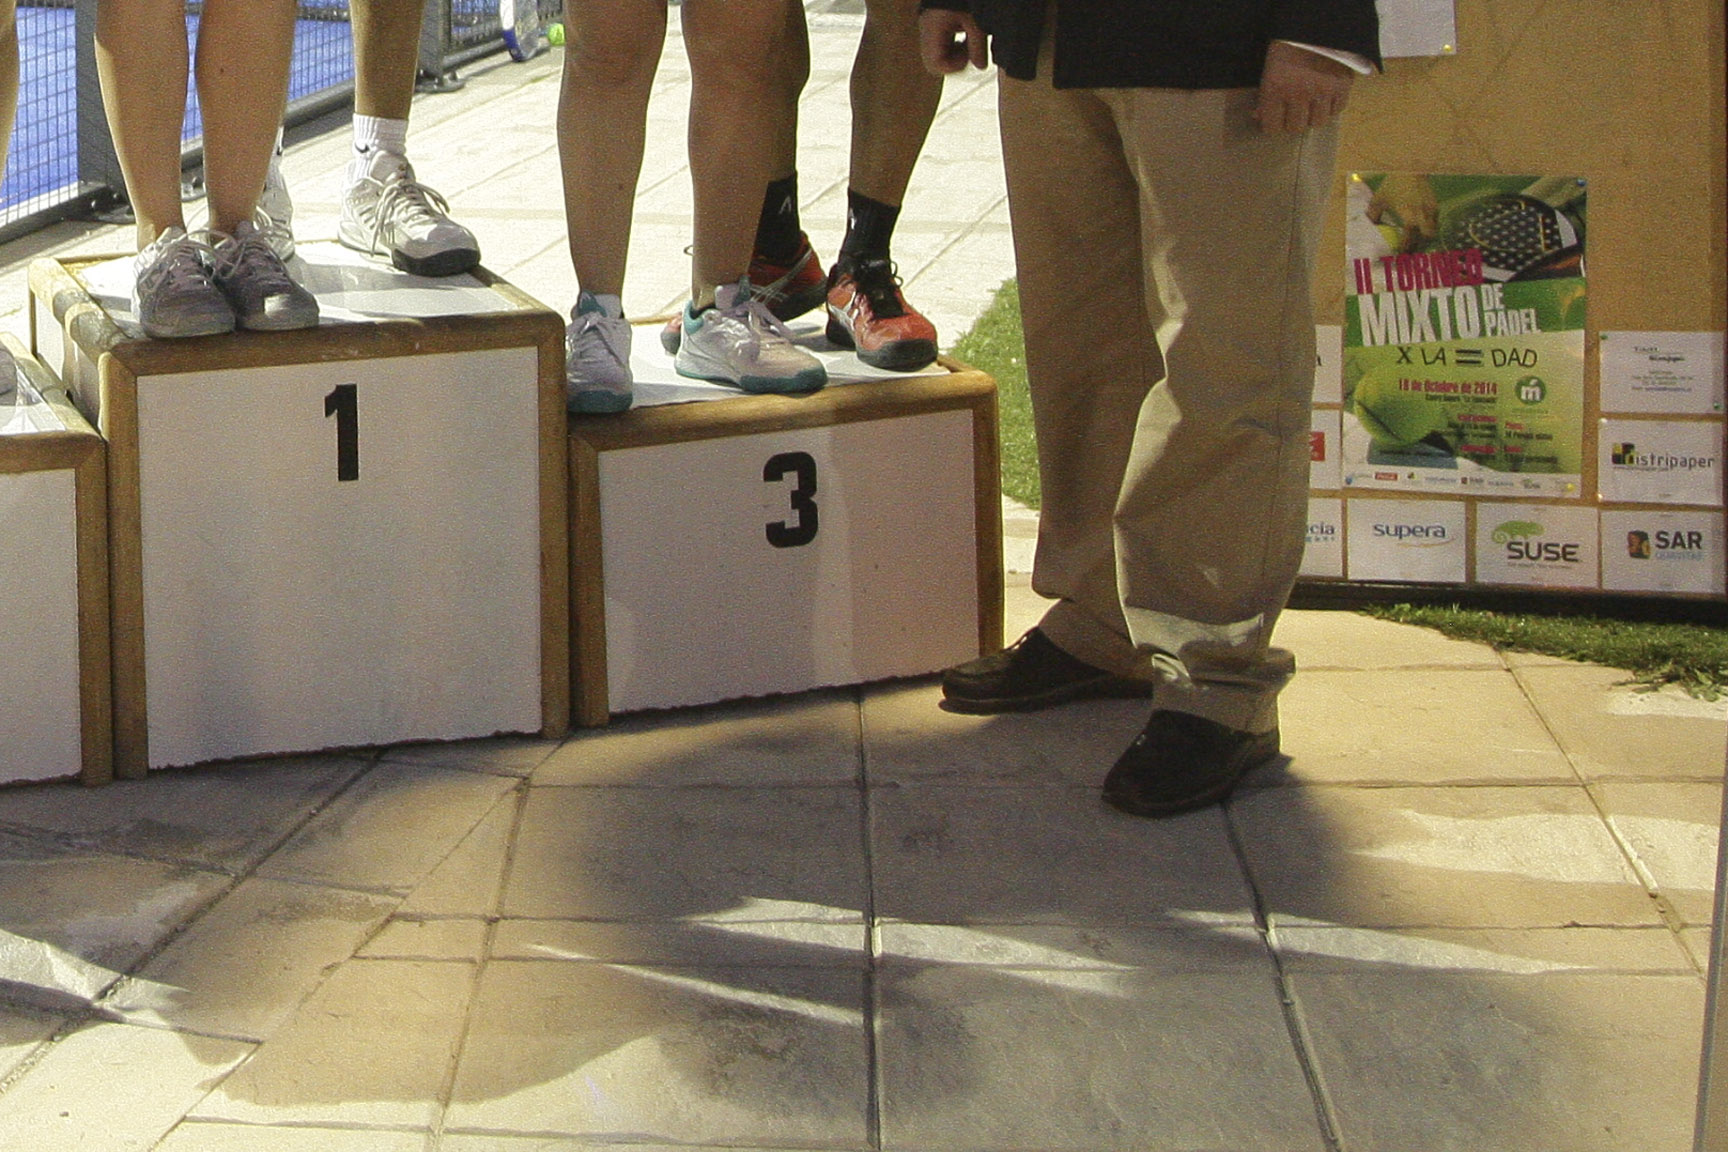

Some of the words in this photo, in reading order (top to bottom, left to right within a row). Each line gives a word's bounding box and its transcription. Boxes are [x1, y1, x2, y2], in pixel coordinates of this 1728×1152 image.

[1354, 258, 1373, 294] II
[1380, 248, 1485, 292] TORNEO
[1358, 285, 1480, 347] MIXTO
[1480, 283, 1505, 310] DE
[1396, 346, 1413, 364] X
[1421, 346, 1446, 366] LA
[1491, 348, 1538, 368] DAD
[1474, 381, 1498, 395] 2014
[325, 385, 359, 481] 1
[763, 452, 819, 548] 3
[1373, 522, 1446, 539] supera
[1655, 530, 1702, 550] SAR
[1507, 541, 1579, 562] SUSE
